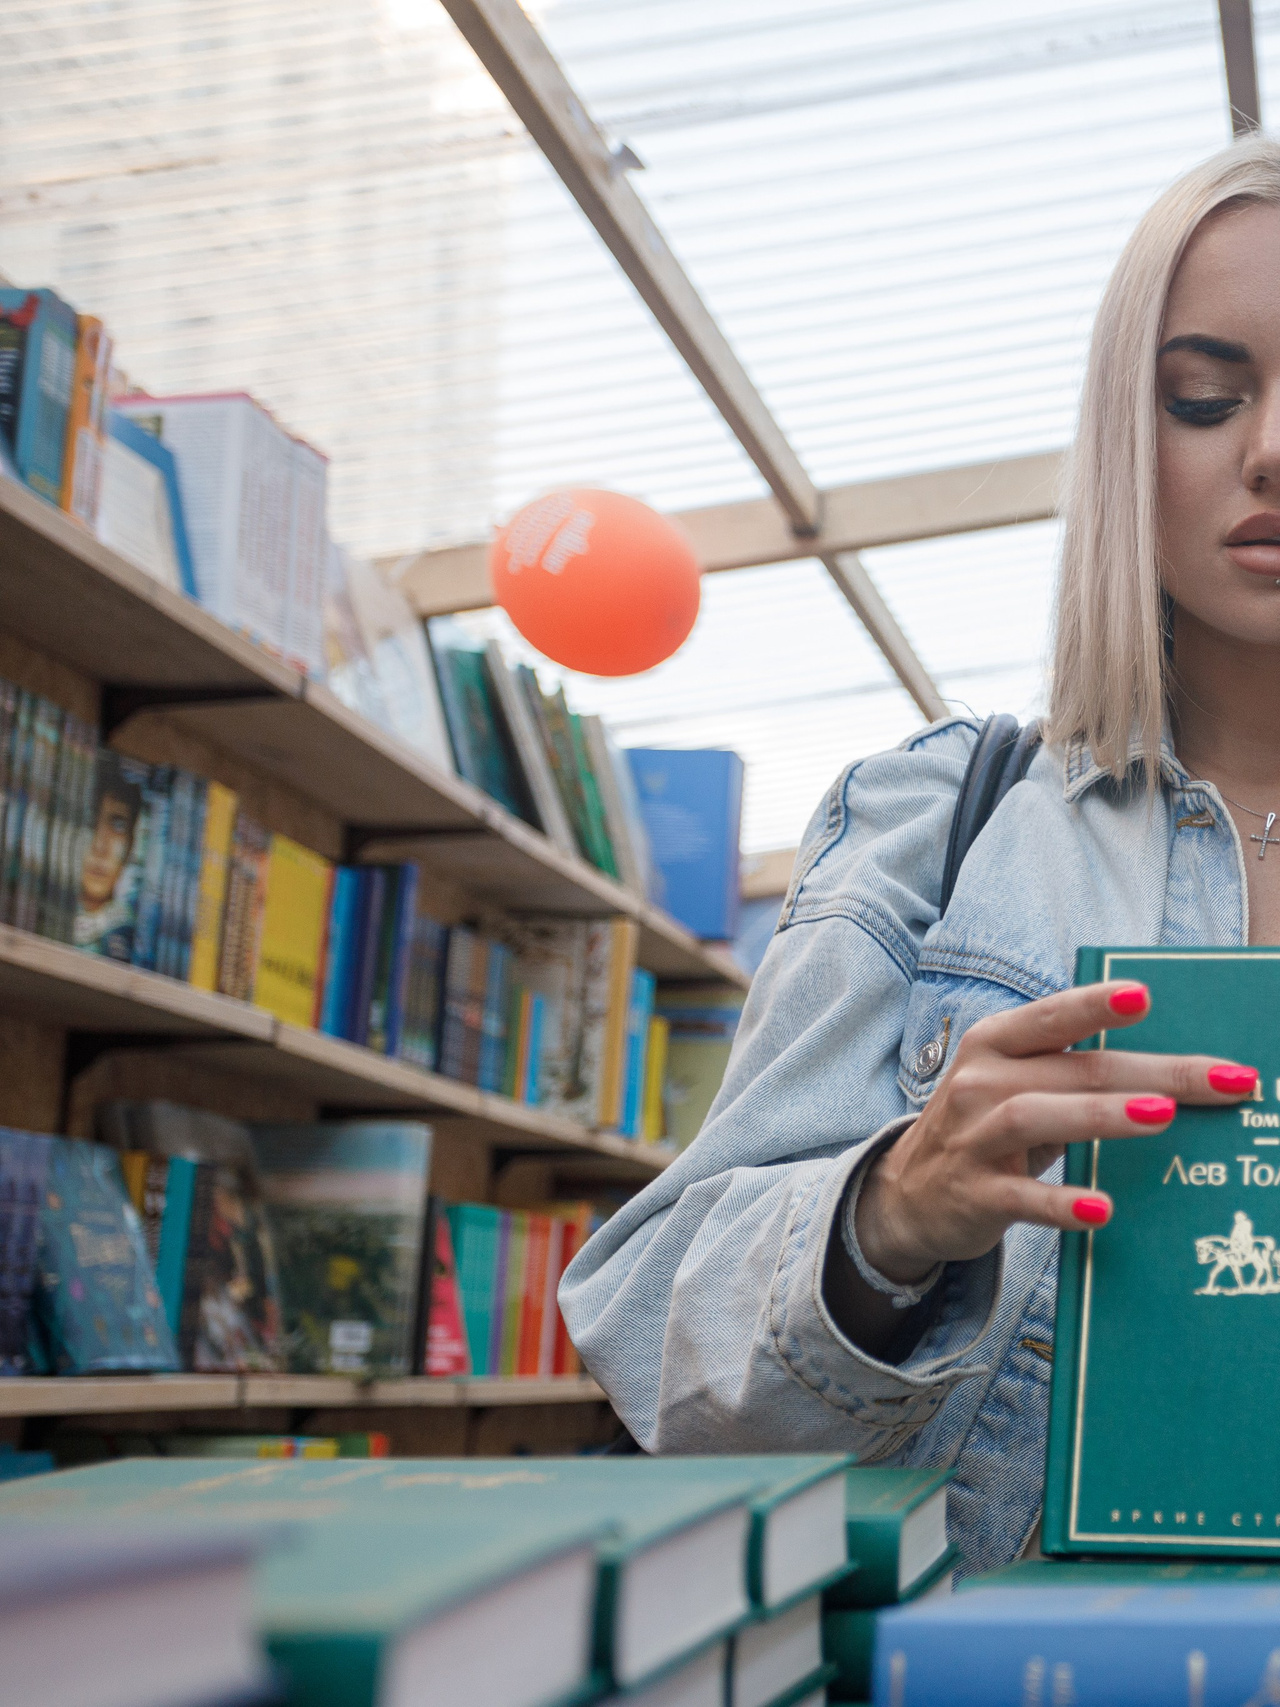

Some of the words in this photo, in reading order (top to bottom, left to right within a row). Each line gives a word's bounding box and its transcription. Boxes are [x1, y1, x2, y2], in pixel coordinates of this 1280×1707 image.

[1239, 1108, 1280, 1128] Том
[1162, 1155, 1227, 1186] Лев
[1110, 1509, 1205, 1526] ЯРКИЕ
